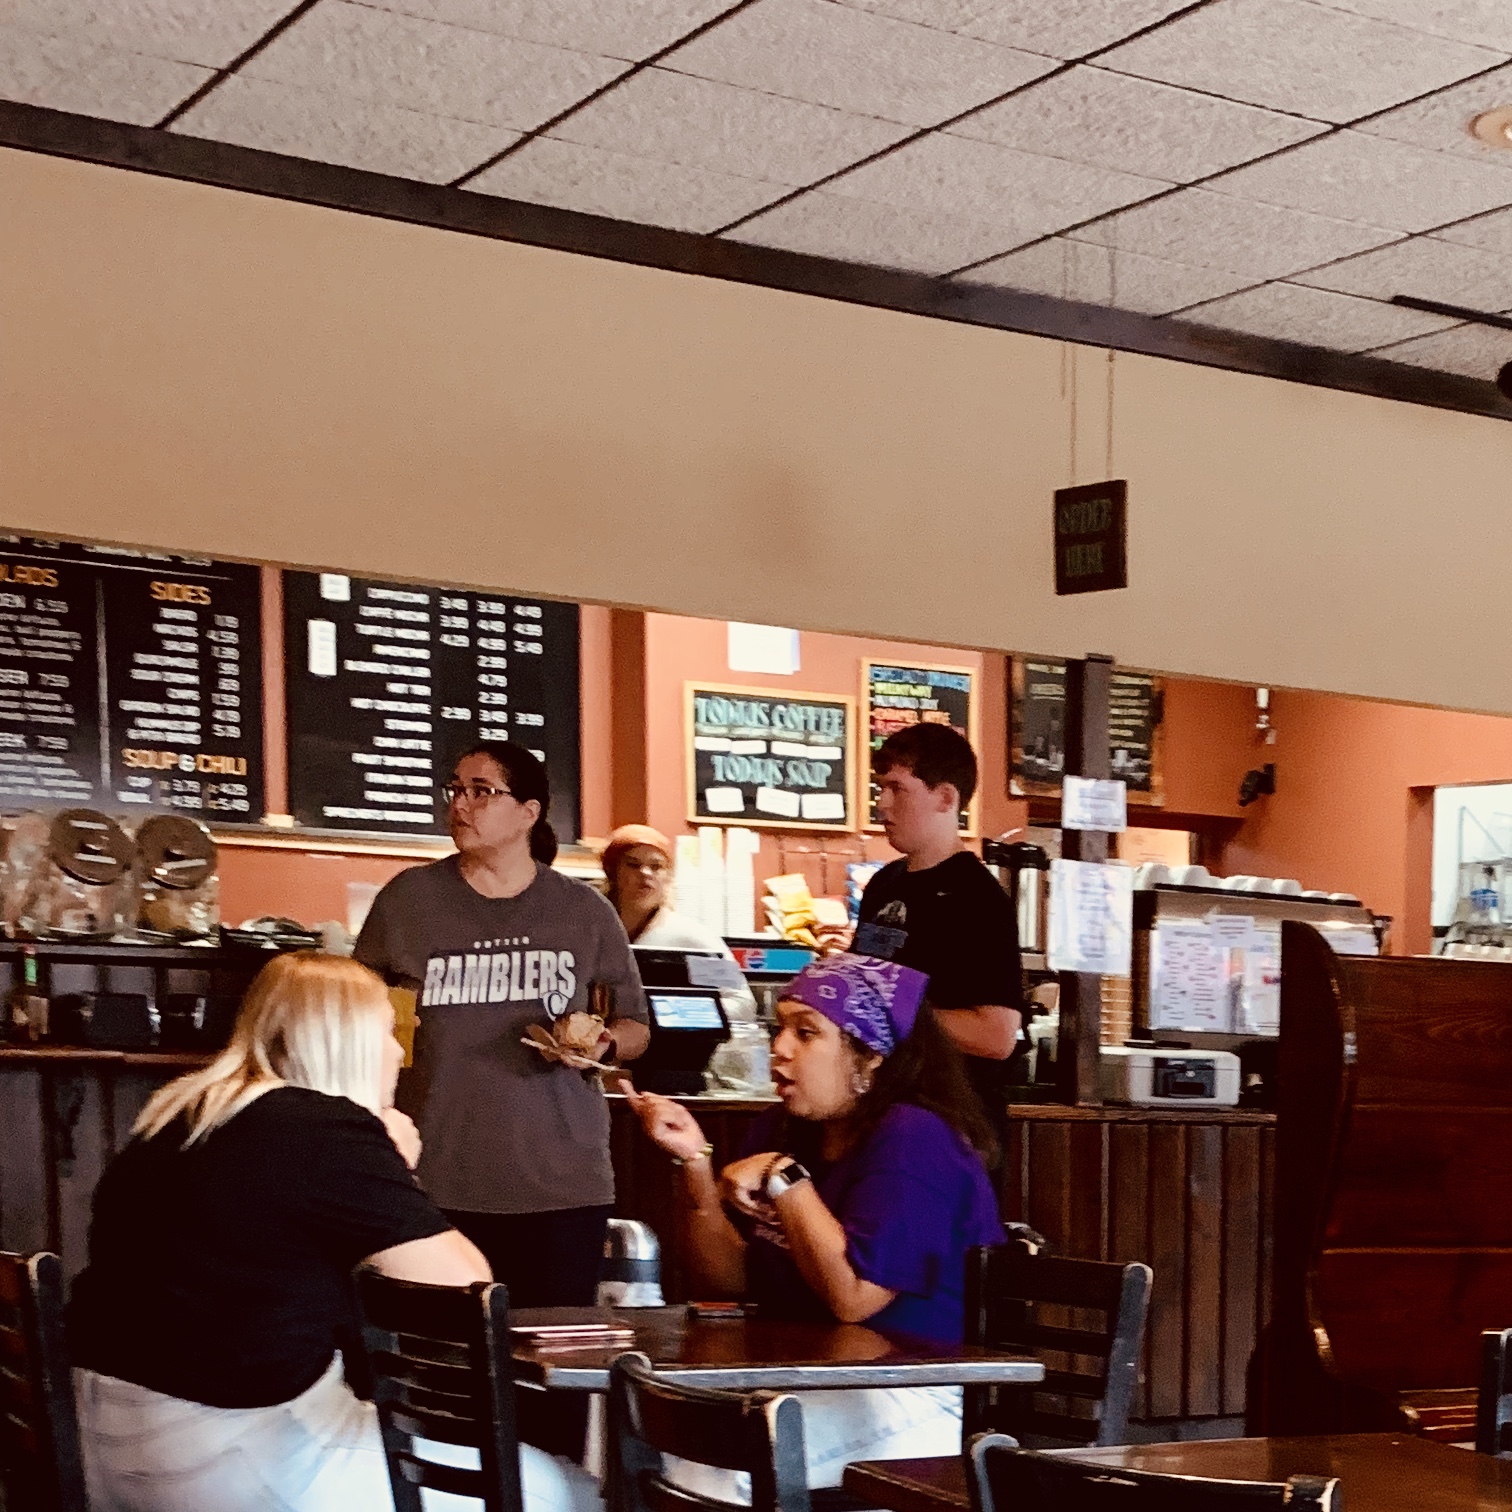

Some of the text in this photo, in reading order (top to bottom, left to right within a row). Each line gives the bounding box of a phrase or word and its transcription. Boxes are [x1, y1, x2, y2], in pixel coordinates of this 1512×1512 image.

[150, 580, 212, 606] SIDES
[771, 702, 845, 738] COFFEE
[120, 748, 179, 770] SOUP
[195, 753, 248, 776] CHILI
[421, 950, 577, 1007] RAMBLERS
